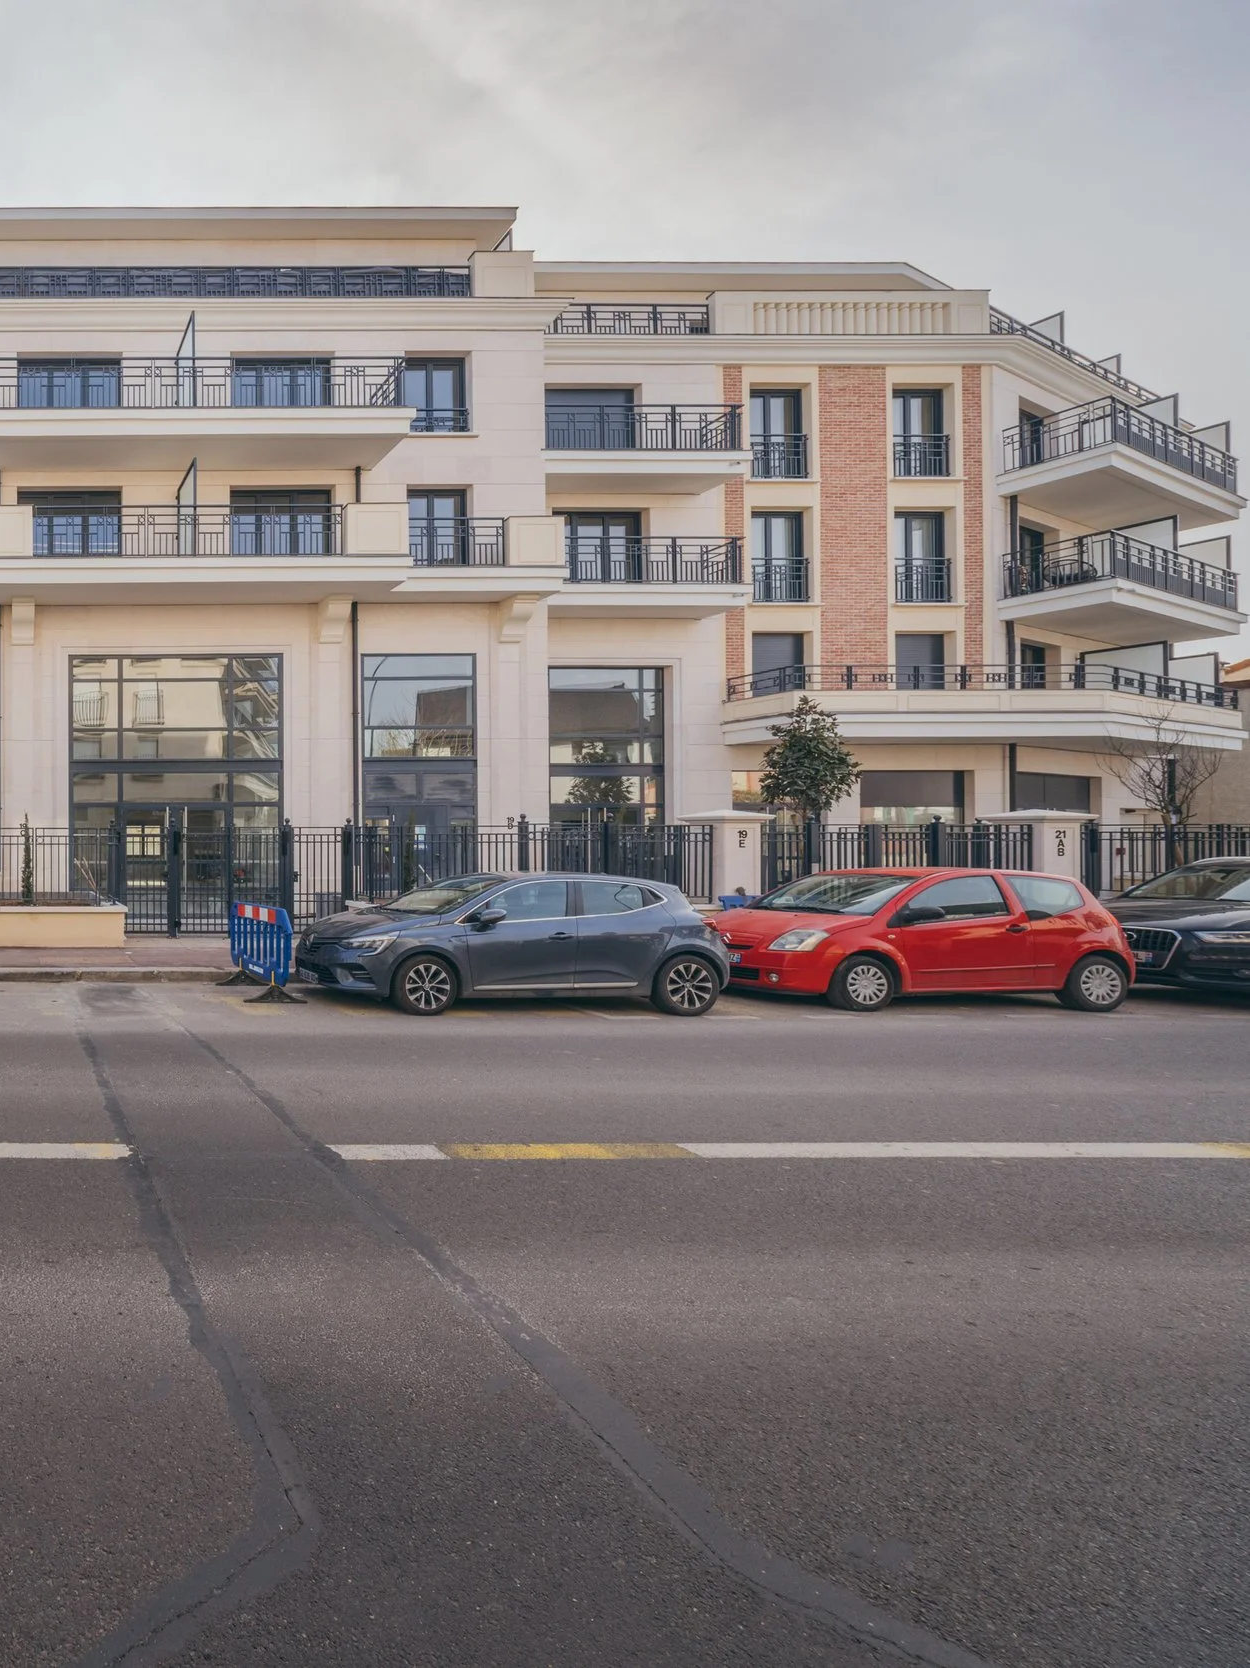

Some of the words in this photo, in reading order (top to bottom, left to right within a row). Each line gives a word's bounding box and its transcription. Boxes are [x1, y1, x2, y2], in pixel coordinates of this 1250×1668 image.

[737, 830, 747, 838] 19
[1055, 830, 1066, 838] 21
[739, 840, 745, 848] E
[1057, 839, 1064, 847] A
[1058, 848, 1064, 856] B
